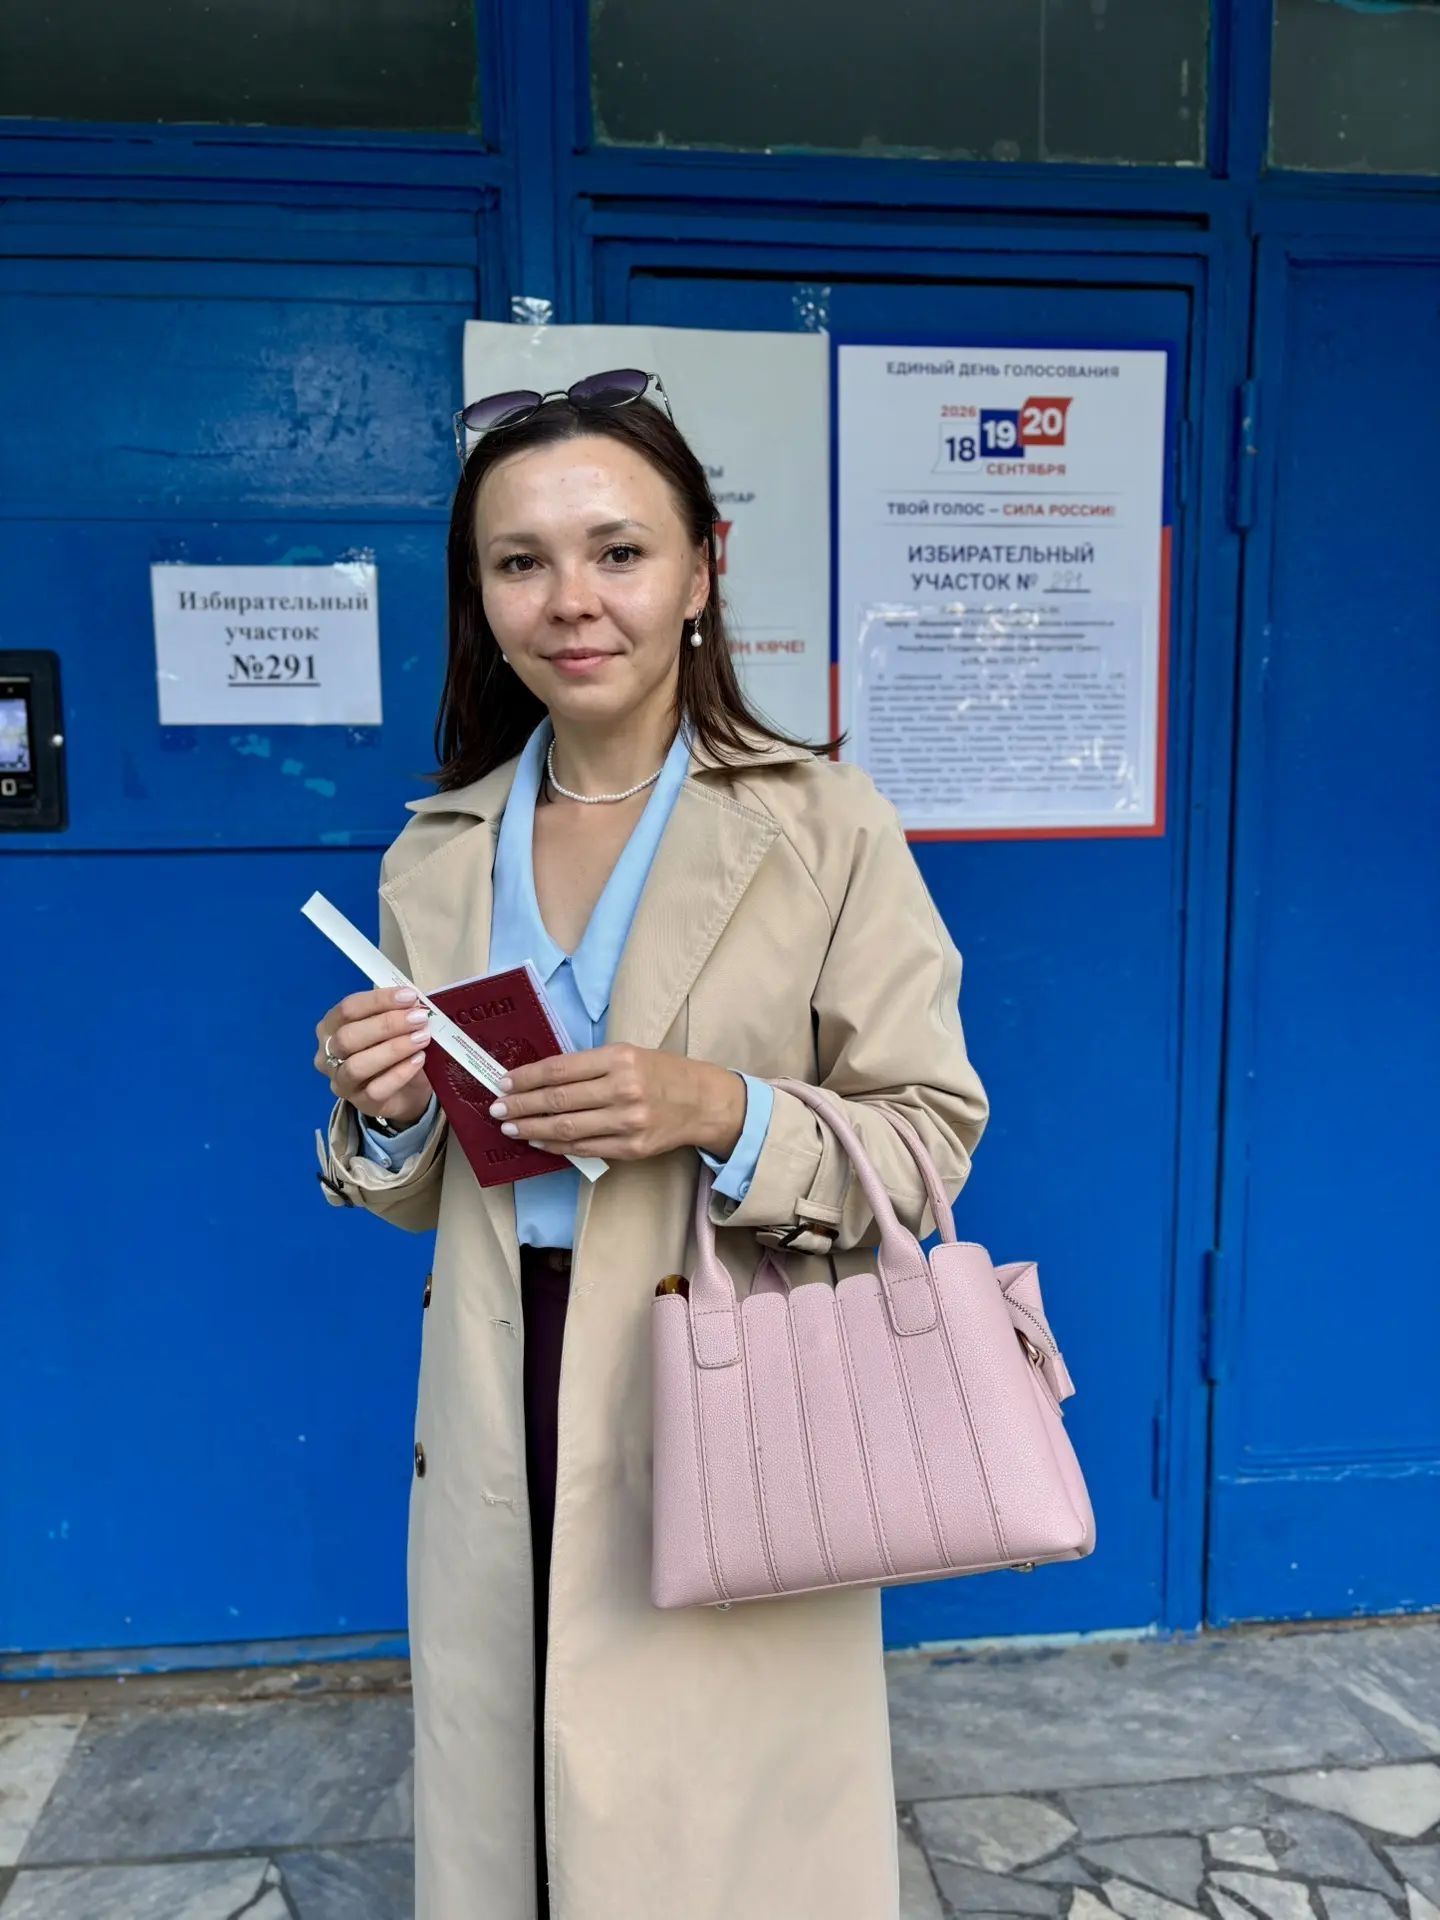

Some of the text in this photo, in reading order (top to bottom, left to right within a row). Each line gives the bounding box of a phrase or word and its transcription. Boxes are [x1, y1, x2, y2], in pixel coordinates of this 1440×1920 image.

[886, 360, 1119, 378] ЕДИНЫЙ ДЕНЬ ГОЛОСОВАНИЯ
[940, 405, 977, 418] 2026
[1022, 407, 1062, 436] 20
[983, 420, 1016, 449] 19
[945, 437, 976, 462] 18
[986, 463, 1066, 476] СЕНТЯБРЯ
[887, 500, 930, 516] ТВОЙ
[933, 503, 985, 516] ГОЛОС
[1003, 504, 1045, 517] СИЛА
[1050, 505, 1115, 517] РОССИИ!
[908, 542, 1094, 564] ИЗБИРАТЕЛЬНЫЙ
[911, 572, 1038, 592] УЧАСТОК №
[178, 591, 369, 616] Избирательный
[225, 624, 320, 646] участок
[228, 653, 319, 682] №291
